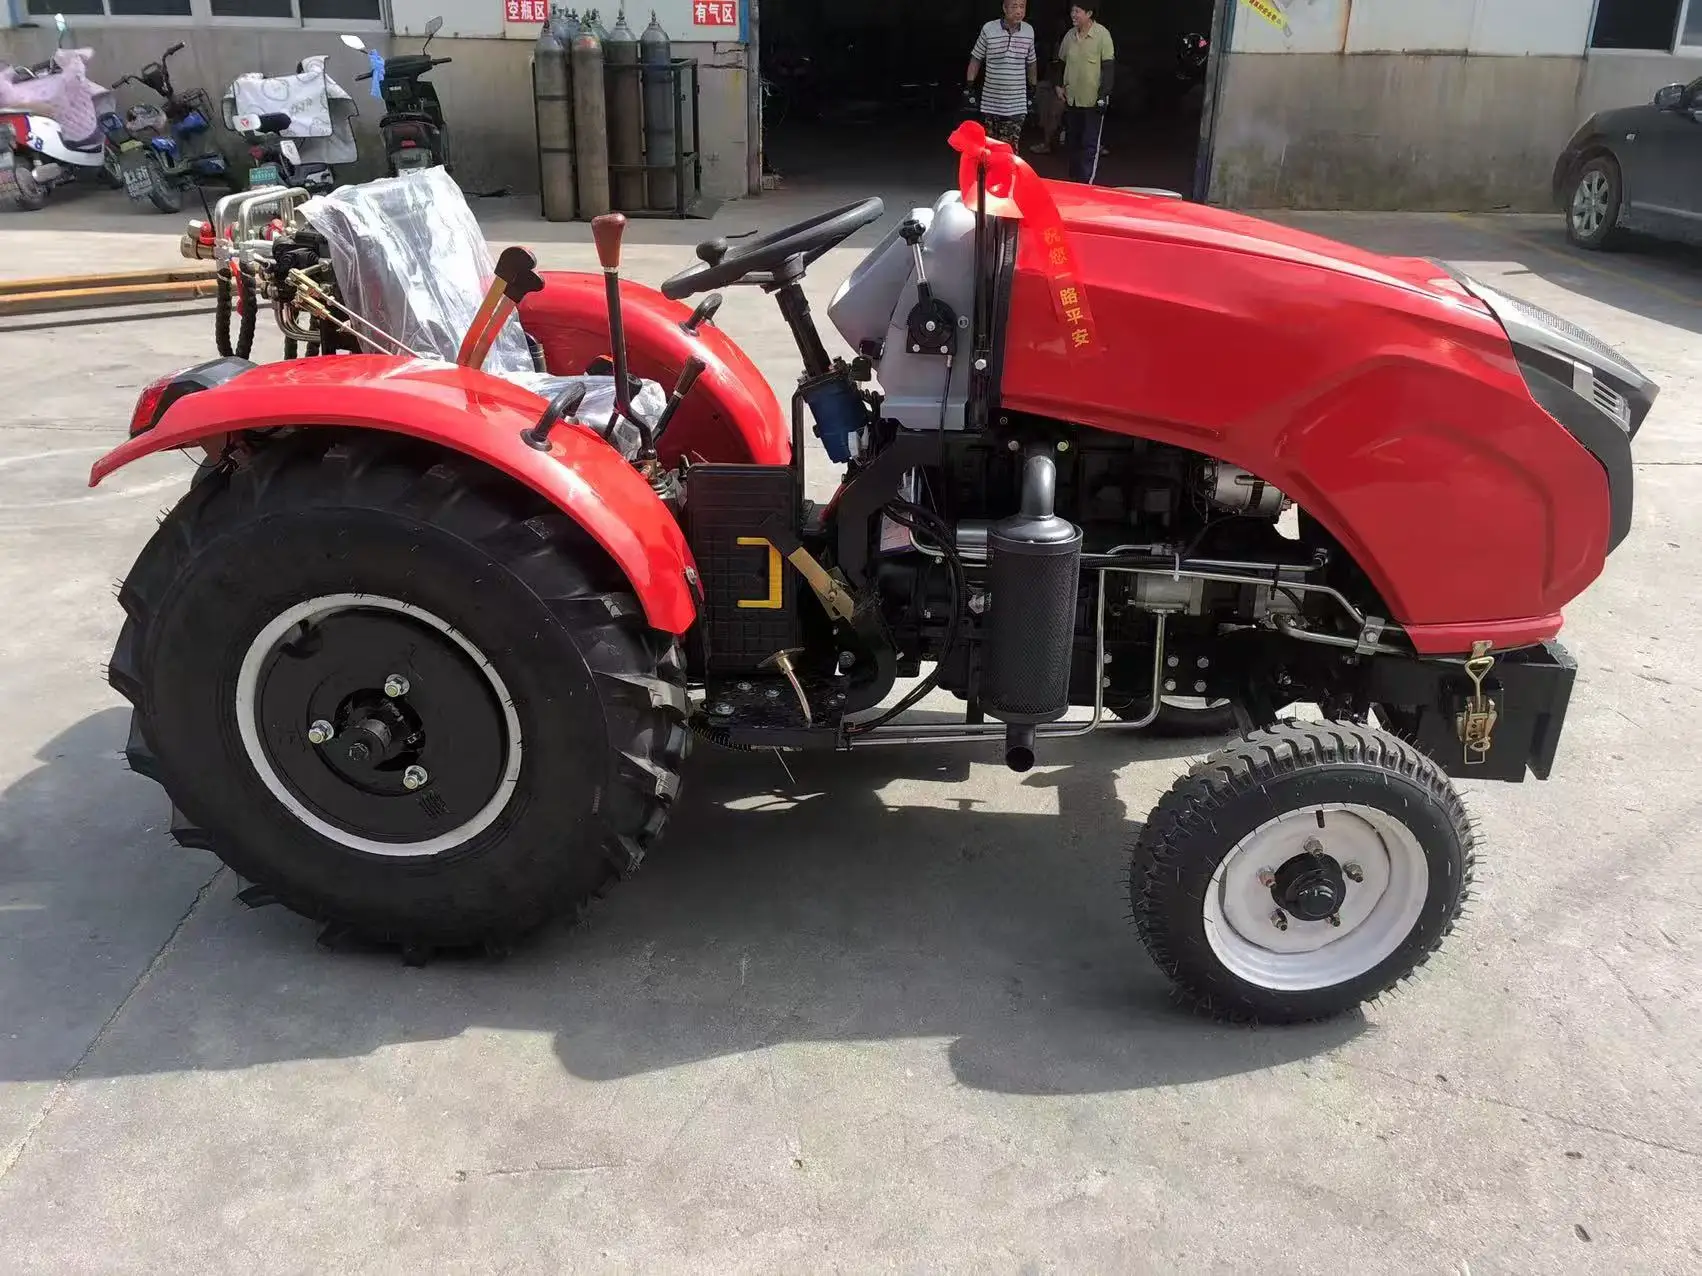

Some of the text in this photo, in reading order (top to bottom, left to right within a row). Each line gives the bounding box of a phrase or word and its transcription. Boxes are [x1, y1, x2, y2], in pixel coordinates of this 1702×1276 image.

[508, 0, 546, 20] 空瓶区
[695, 2, 733, 23] 有气区
